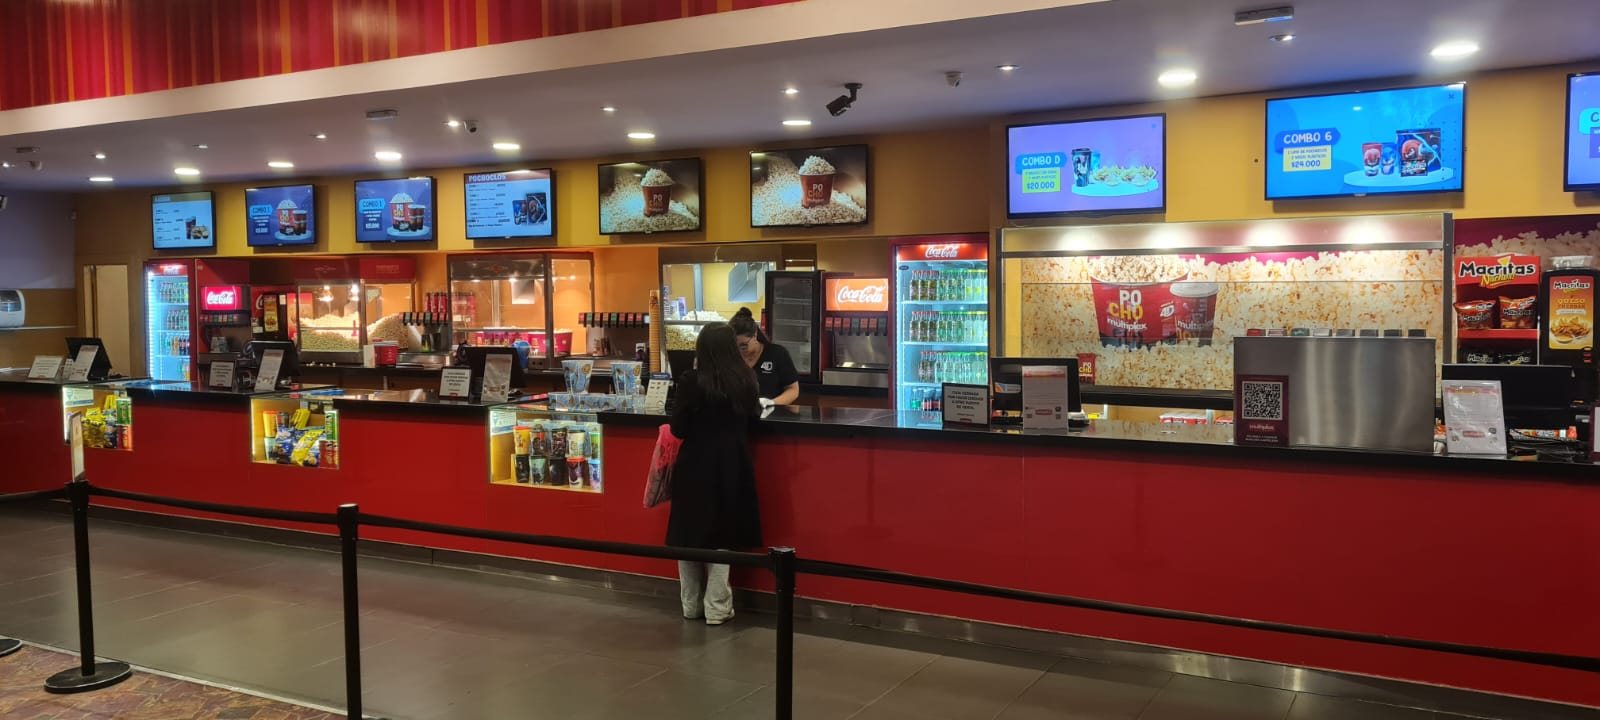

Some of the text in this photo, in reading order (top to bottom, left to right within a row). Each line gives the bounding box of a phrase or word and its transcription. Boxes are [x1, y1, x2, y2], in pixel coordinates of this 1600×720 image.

[1283, 131, 1332, 144] COMBO 6
[1022, 155, 1061, 166] COMBO D
[1291, 159, 1321, 168] $24.000
[812, 183, 823, 192] PO
[1027, 182, 1055, 190] $20.000
[1459, 261, 1536, 277] Macritas
[1553, 281, 1590, 289] Macritas
[207, 290, 235, 305] Coca-Cola
[837, 285, 884, 303] Coca-Cola
[1119, 289, 1142, 305] PO
[1108, 302, 1143, 320] CHO
[1107, 317, 1147, 331] multiplex
